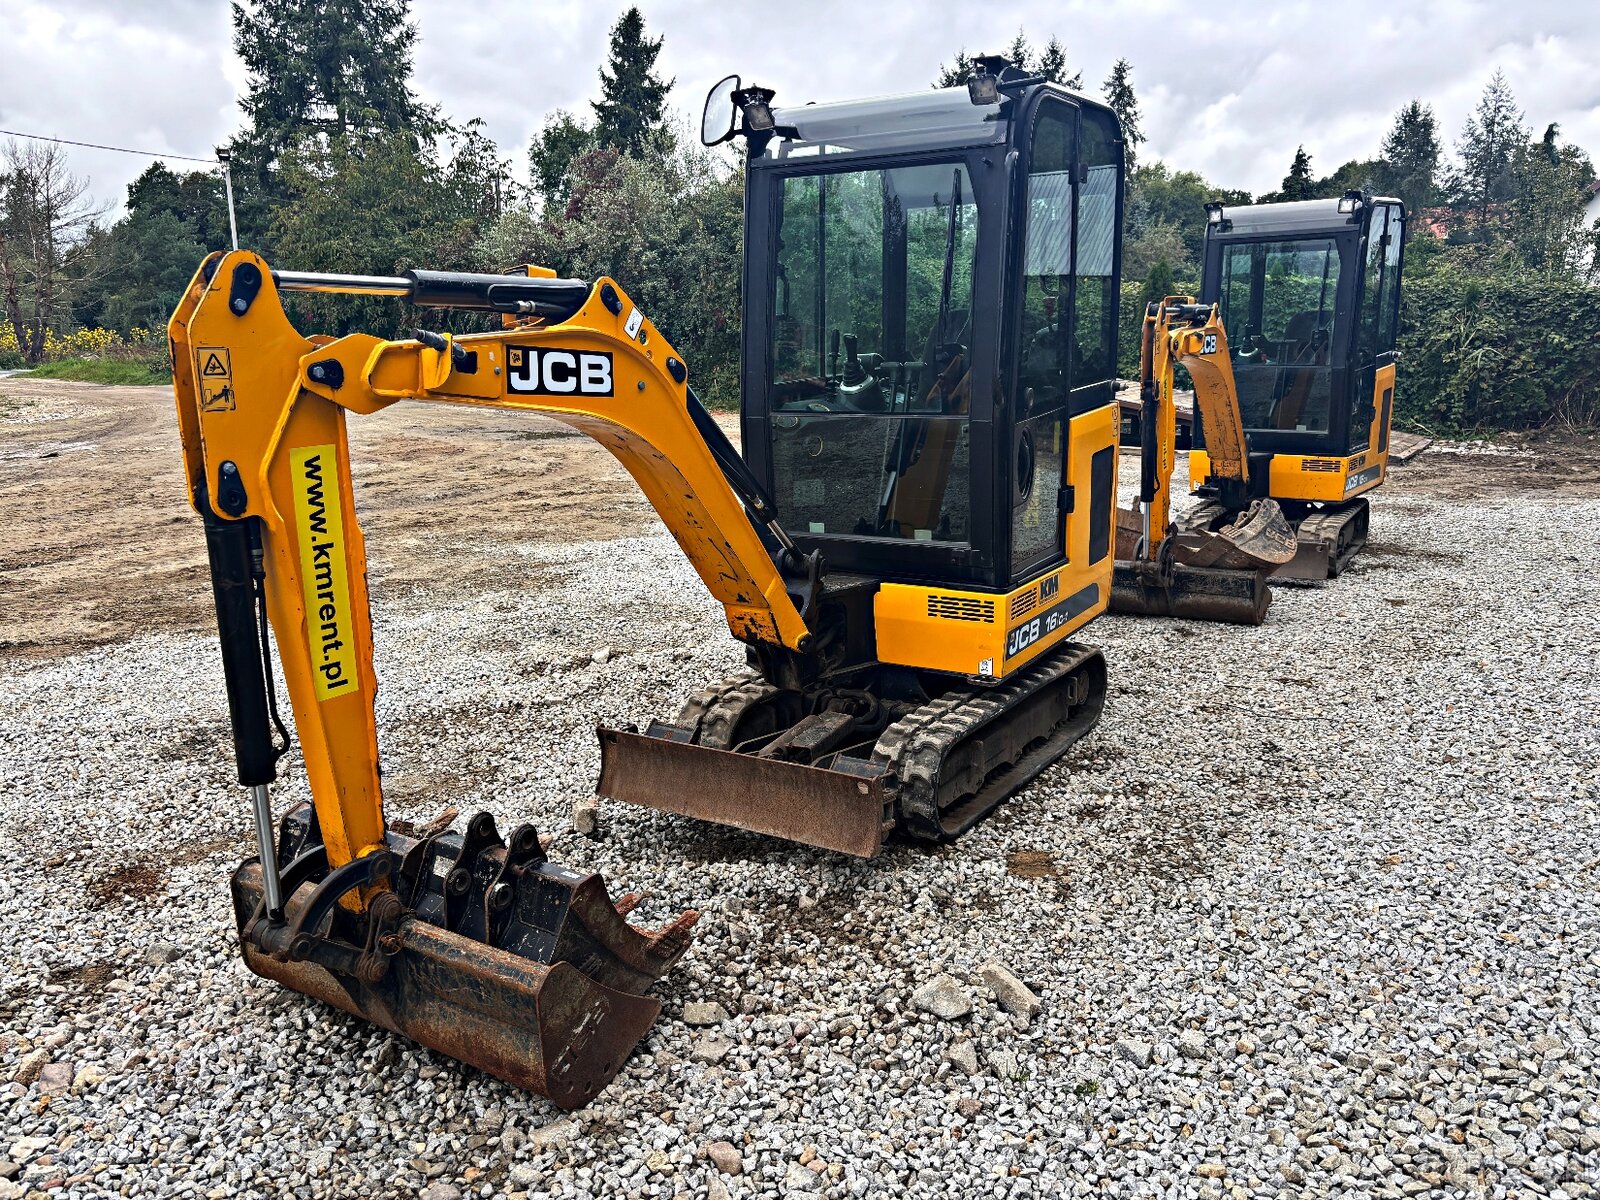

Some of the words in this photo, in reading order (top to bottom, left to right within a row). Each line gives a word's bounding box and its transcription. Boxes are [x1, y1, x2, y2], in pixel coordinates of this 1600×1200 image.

[510, 350, 612, 393] JCB
[303, 454, 349, 690] www.kmrent.pl
[1040, 574, 1059, 600] KM
[1009, 618, 1040, 655] JCB
